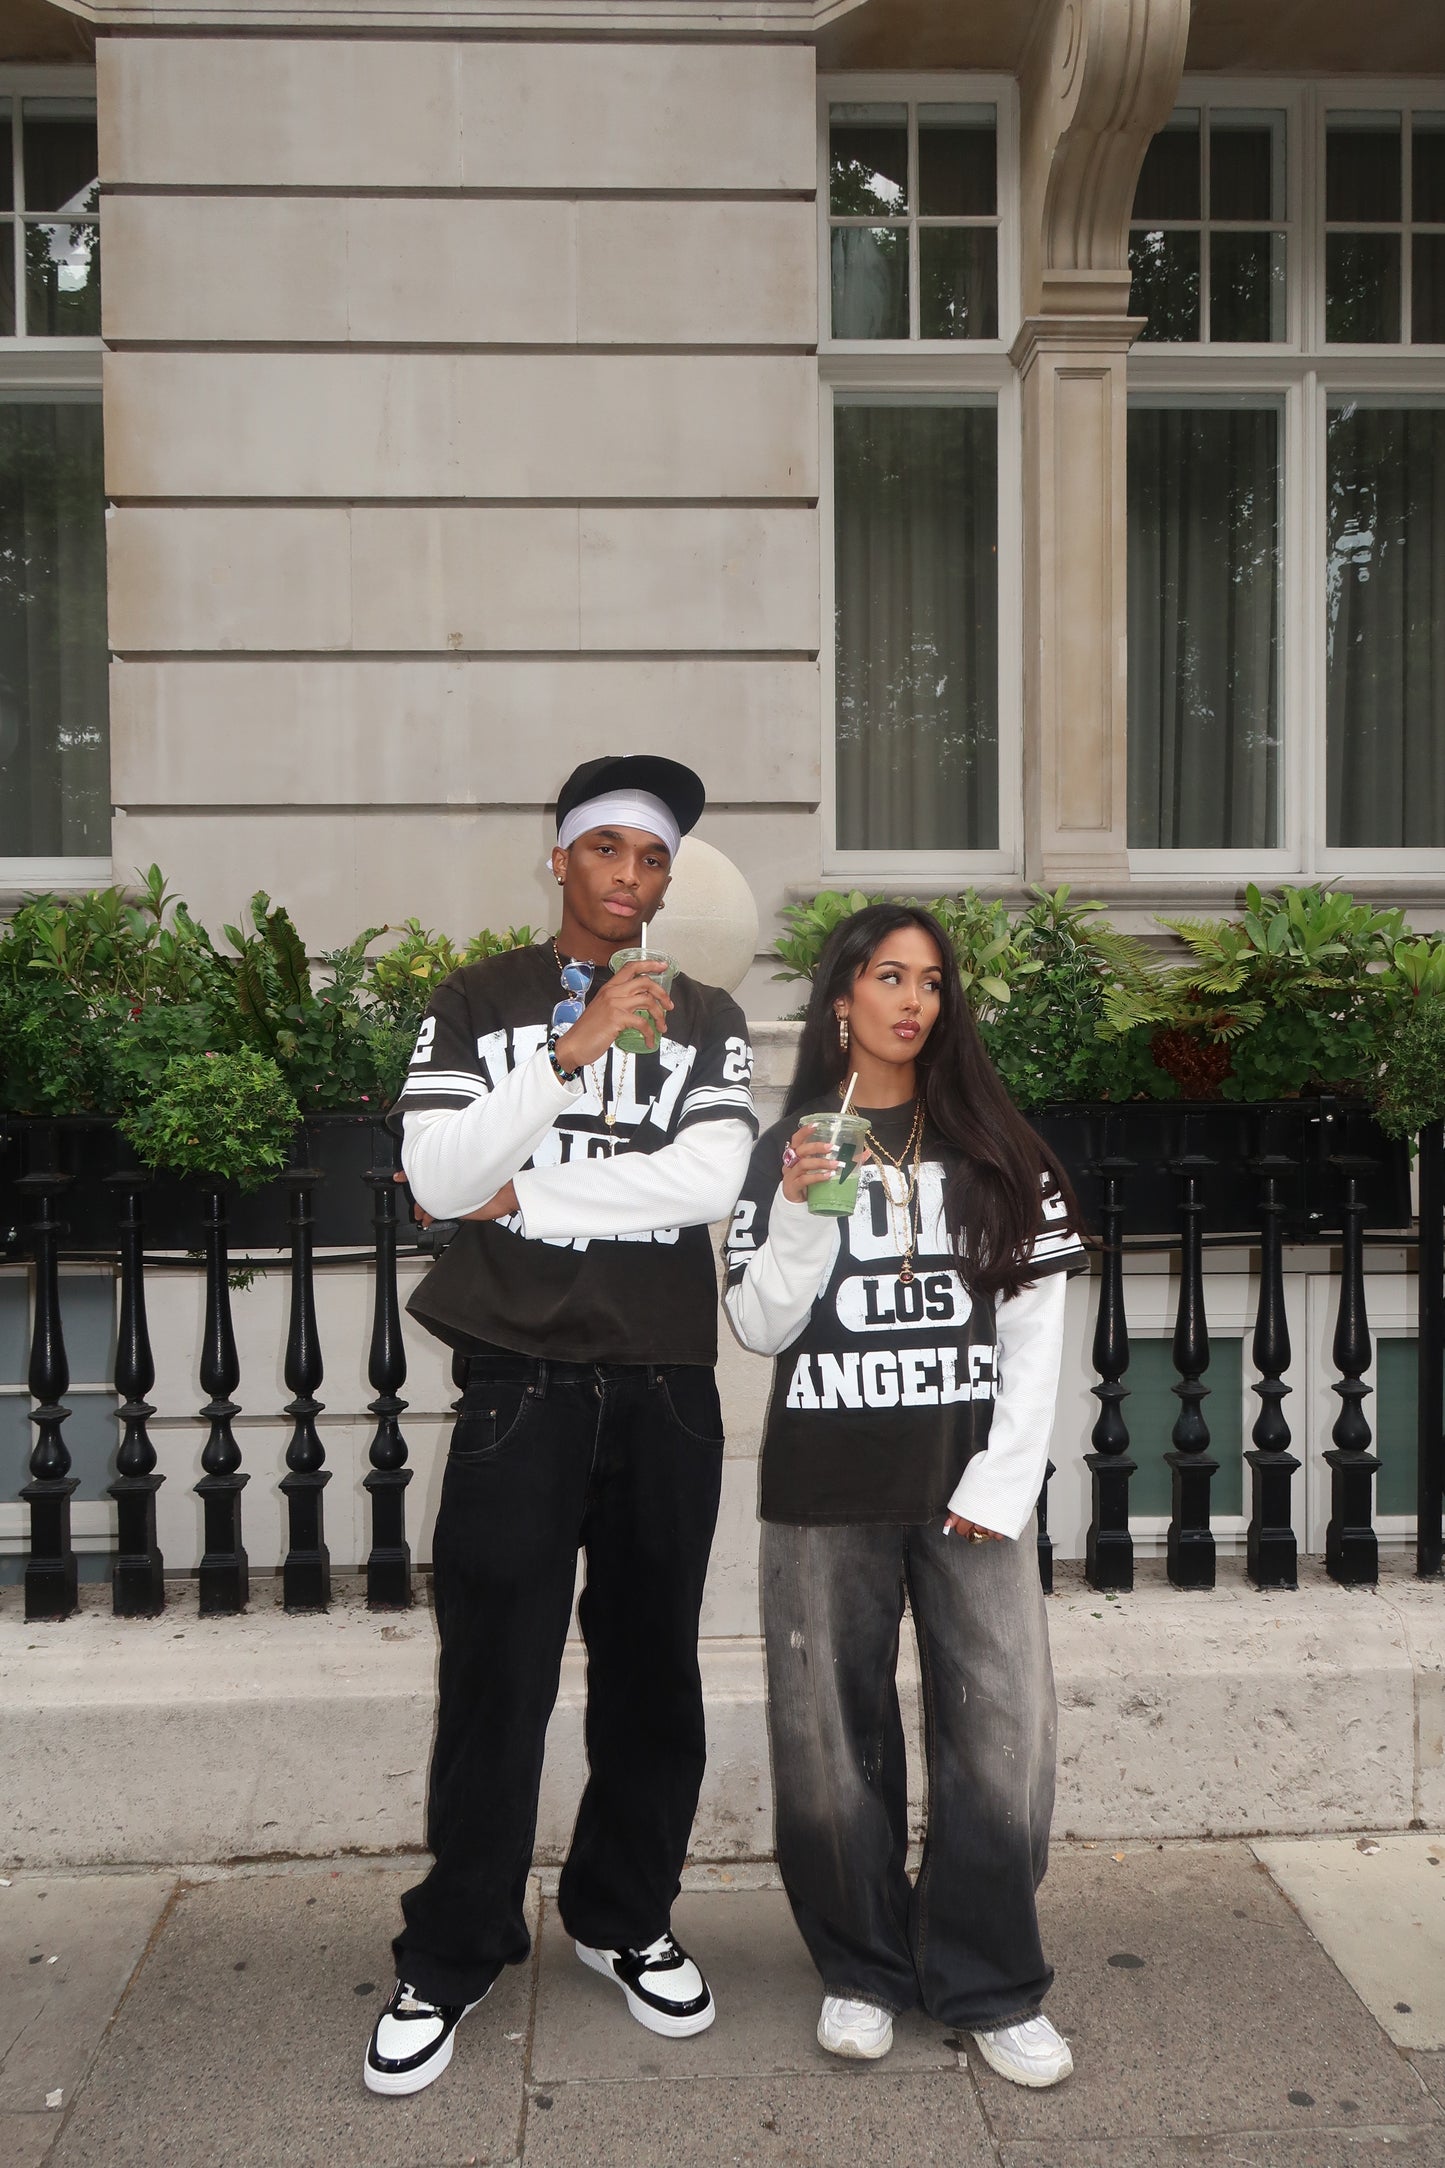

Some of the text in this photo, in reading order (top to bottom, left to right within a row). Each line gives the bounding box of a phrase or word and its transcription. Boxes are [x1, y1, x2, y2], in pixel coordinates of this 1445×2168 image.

[727, 1200, 757, 1248] 2
[863, 1275, 955, 1325] LOS
[786, 1345, 998, 1409] ANGELE
